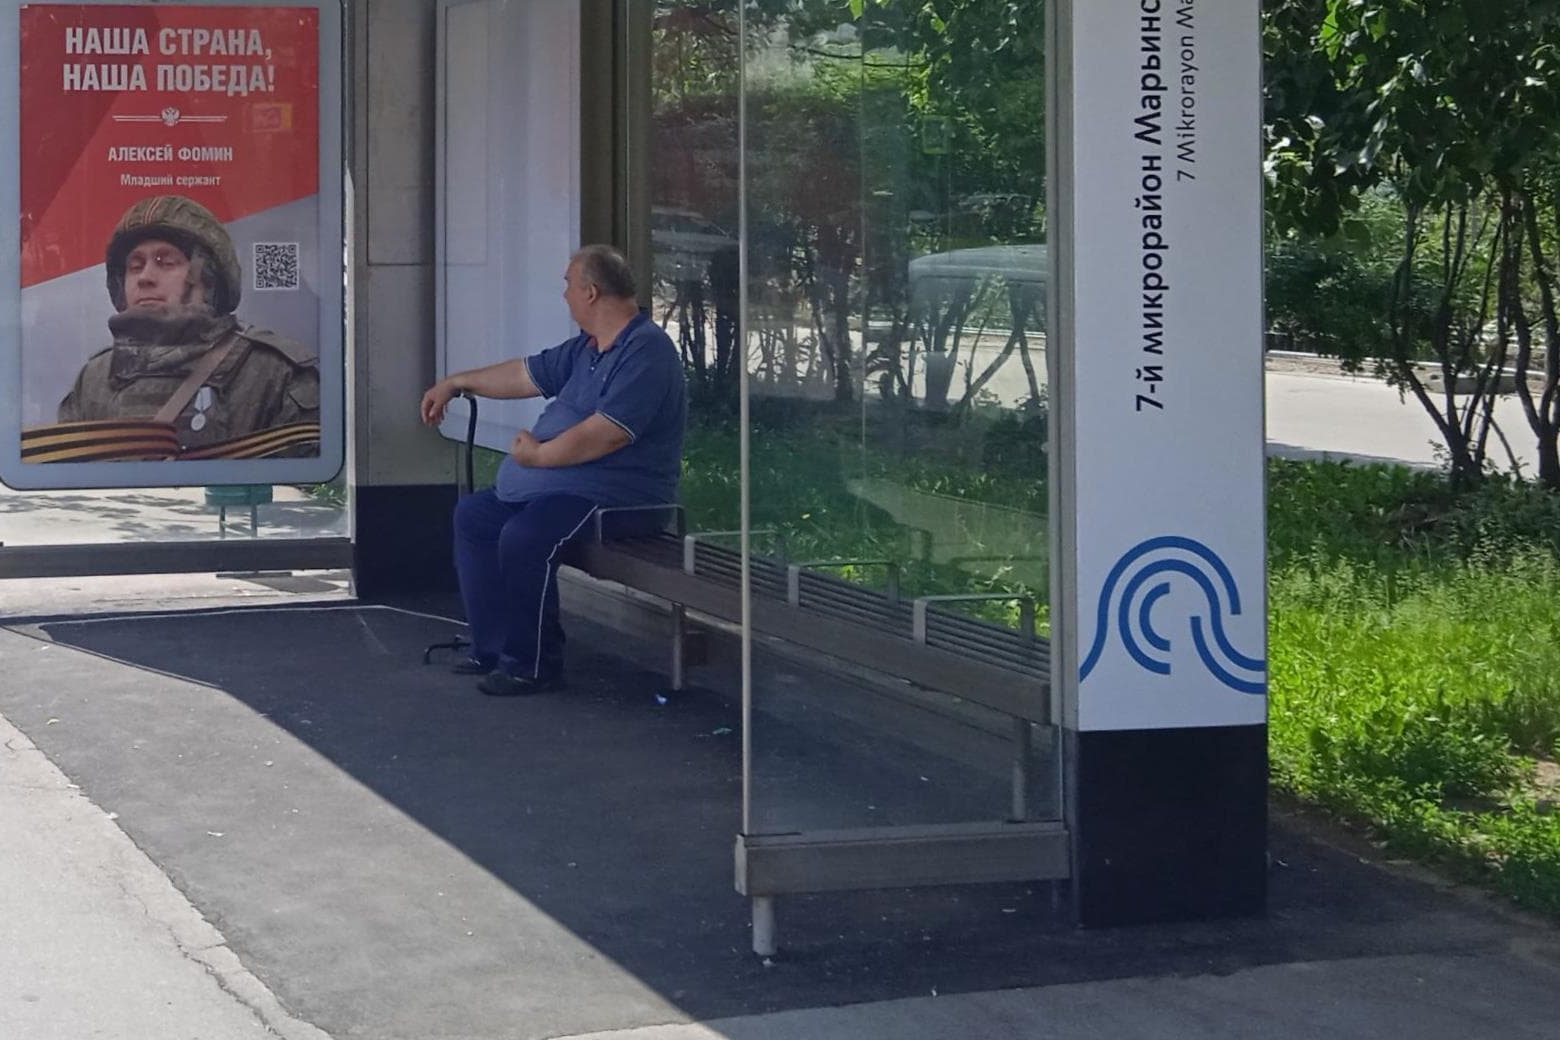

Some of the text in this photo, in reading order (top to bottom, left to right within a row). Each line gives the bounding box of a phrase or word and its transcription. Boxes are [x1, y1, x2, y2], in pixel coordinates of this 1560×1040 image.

[65, 27, 272, 60] НАША СТРАНА,
[62, 64, 275, 97] НАША ПОБЕДА!
[1175, 35, 1200, 163] Mikrorayon
[108, 144, 233, 162] АЛЕКСЕЙ ФОМИН
[120, 173, 221, 188] Младший сержант
[1177, 169, 1196, 182] 7
[1134, 155, 1170, 355] микрорайон
[1135, 365, 1164, 412] 7-й
